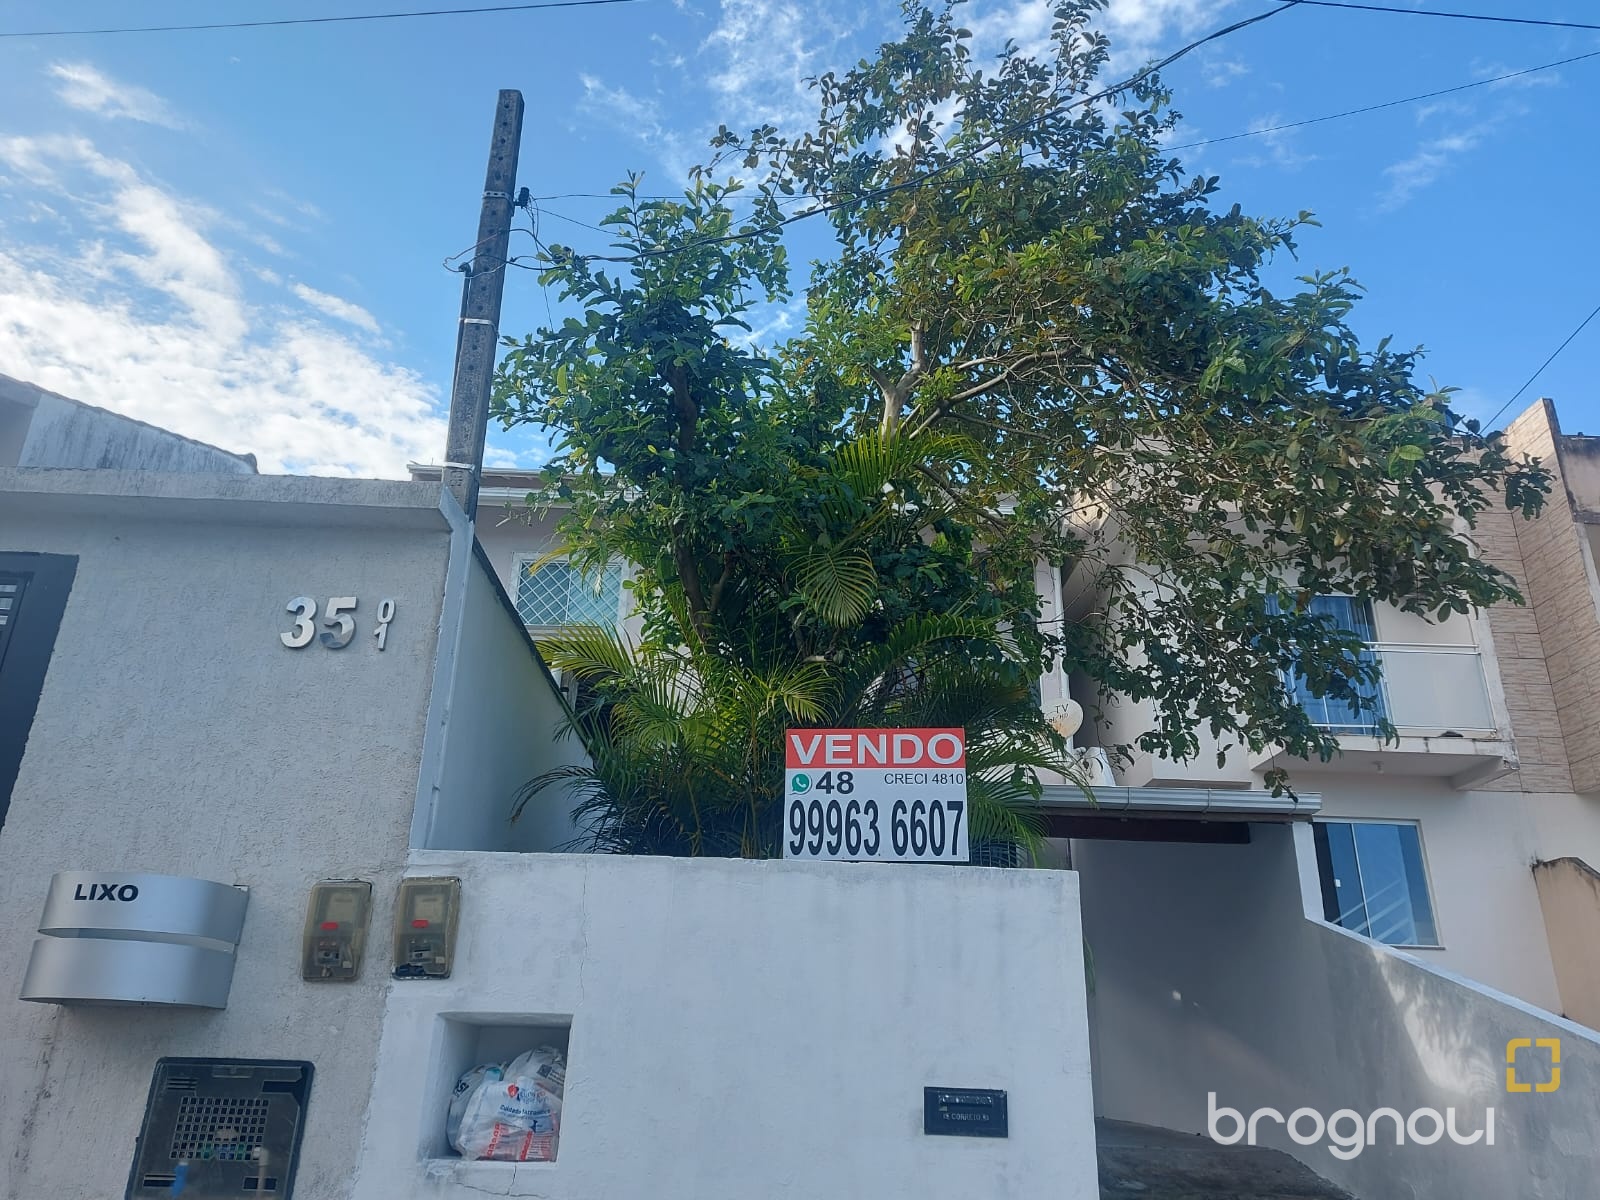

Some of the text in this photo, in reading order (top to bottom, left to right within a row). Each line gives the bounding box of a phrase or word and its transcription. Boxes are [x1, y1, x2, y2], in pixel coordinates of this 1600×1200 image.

[280, 596, 357, 649] 35
[1054, 703, 1069, 714] TV
[790, 733, 963, 765] VENDO
[815, 771, 855, 795] 48
[884, 773, 964, 785] CRECI 4810
[789, 799, 964, 857] 99963 6607
[74, 884, 139, 902] LIXO
